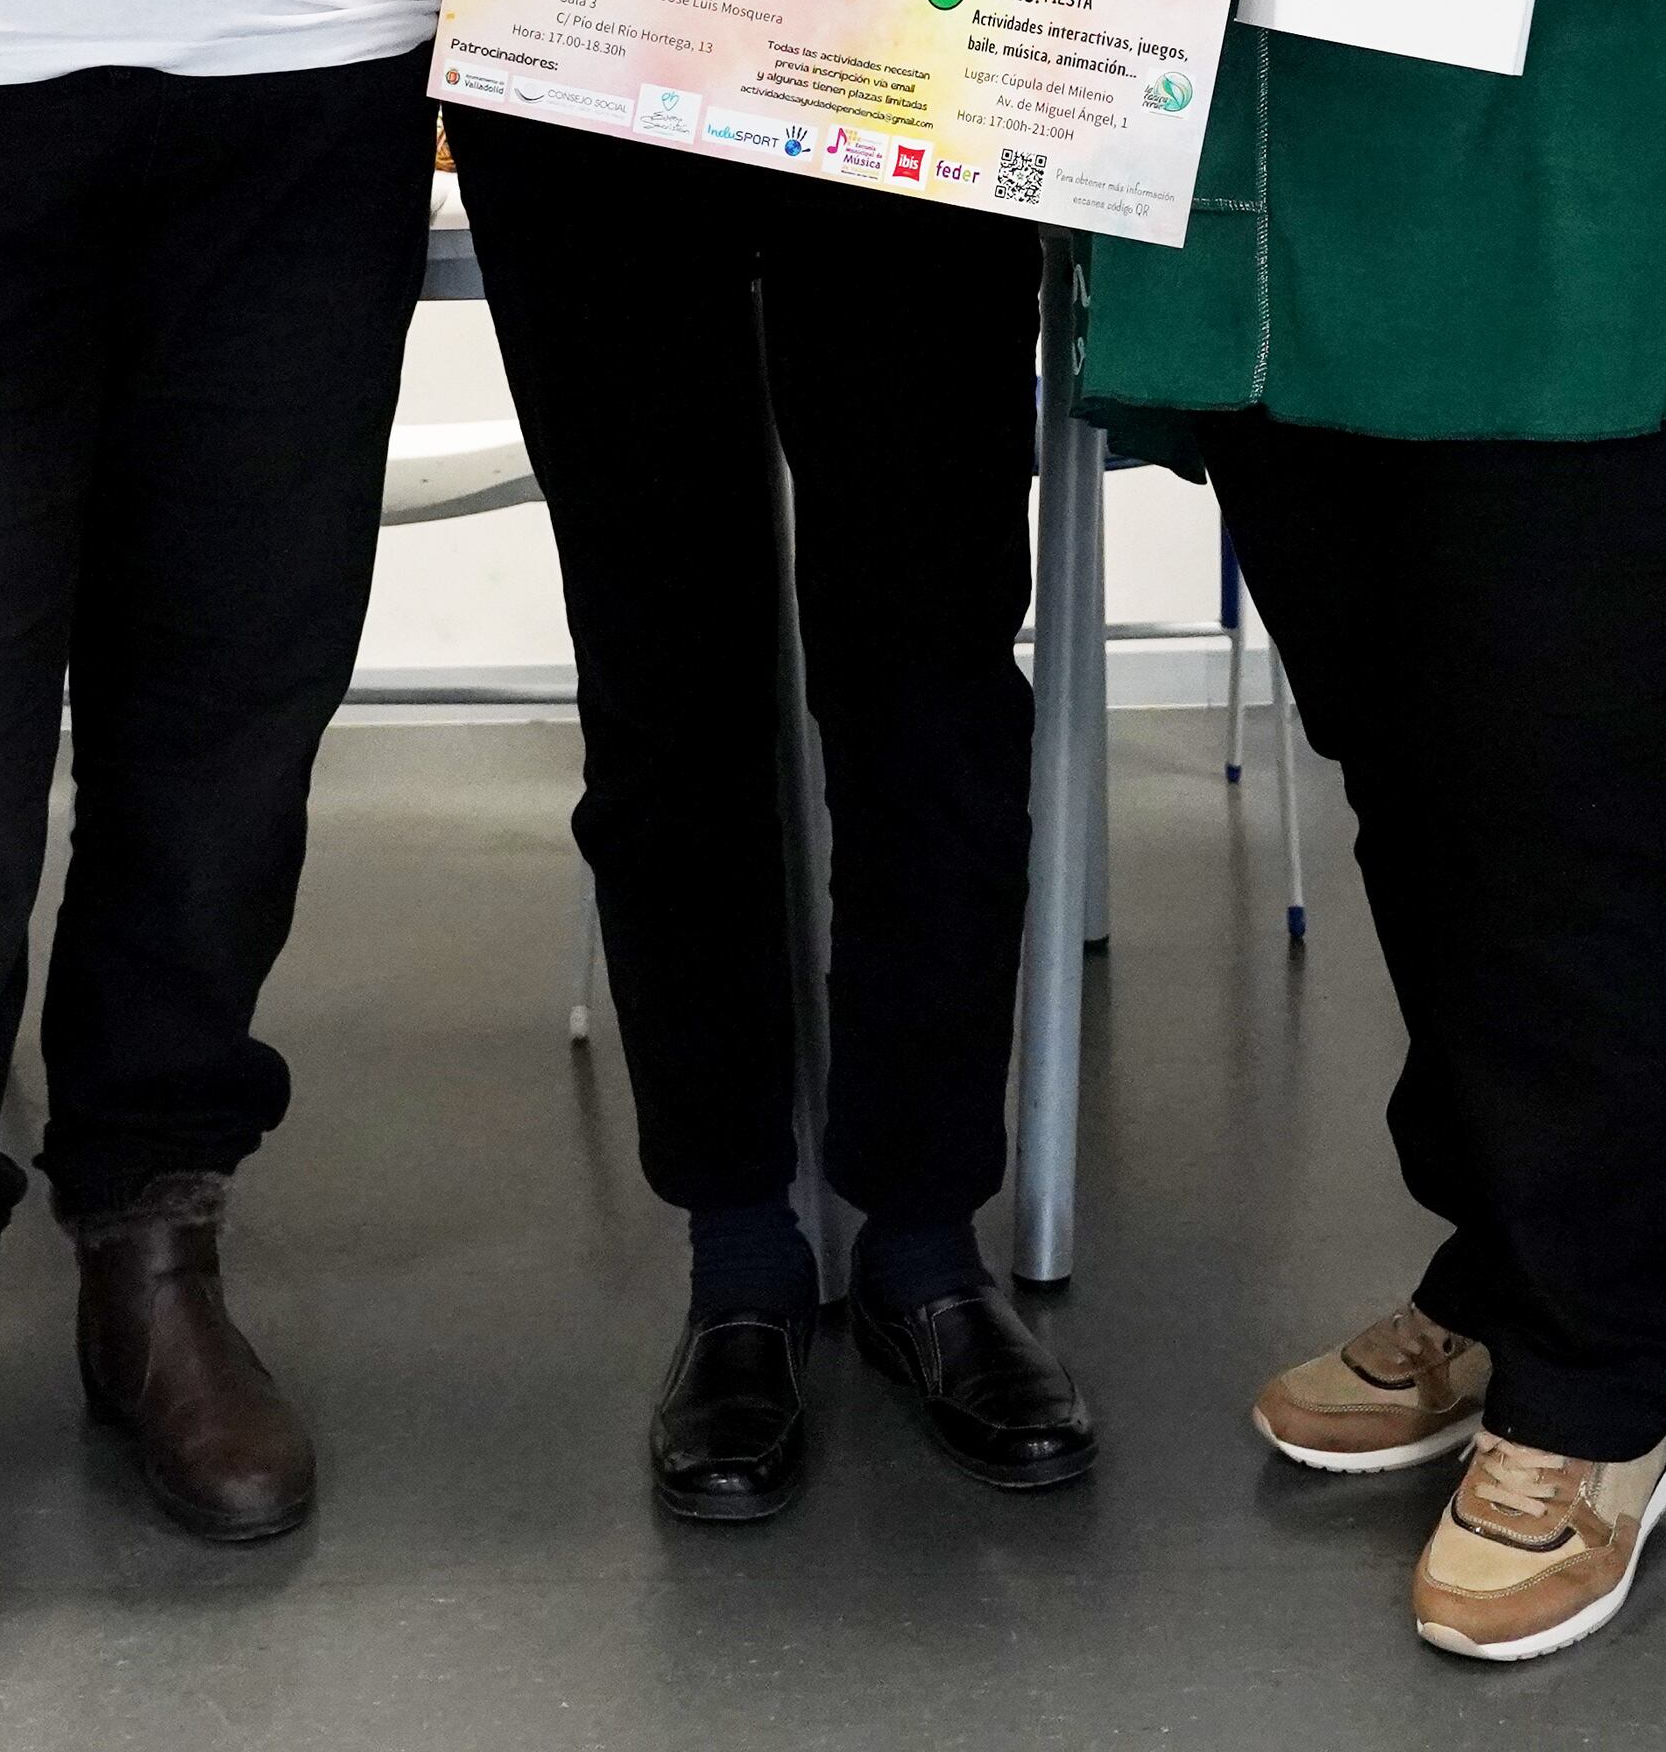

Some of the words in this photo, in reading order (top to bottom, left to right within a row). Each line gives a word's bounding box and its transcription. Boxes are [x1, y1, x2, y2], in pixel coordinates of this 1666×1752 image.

[971, 9, 1044, 35] Actividades
[1047, 21, 1133, 53] interactivas,
[1137, 36, 1188, 62] juegos,
[450, 38, 559, 71] Patrocinadores:
[967, 35, 998, 56] baile,
[1002, 43, 1051, 65] música,
[1055, 52, 1137, 79] animación...
[547, 88, 593, 106] CONSEJO
[593, 98, 627, 114] SOCIAL
[896, 152, 921, 172] ibis
[936, 159, 981, 184] feder
